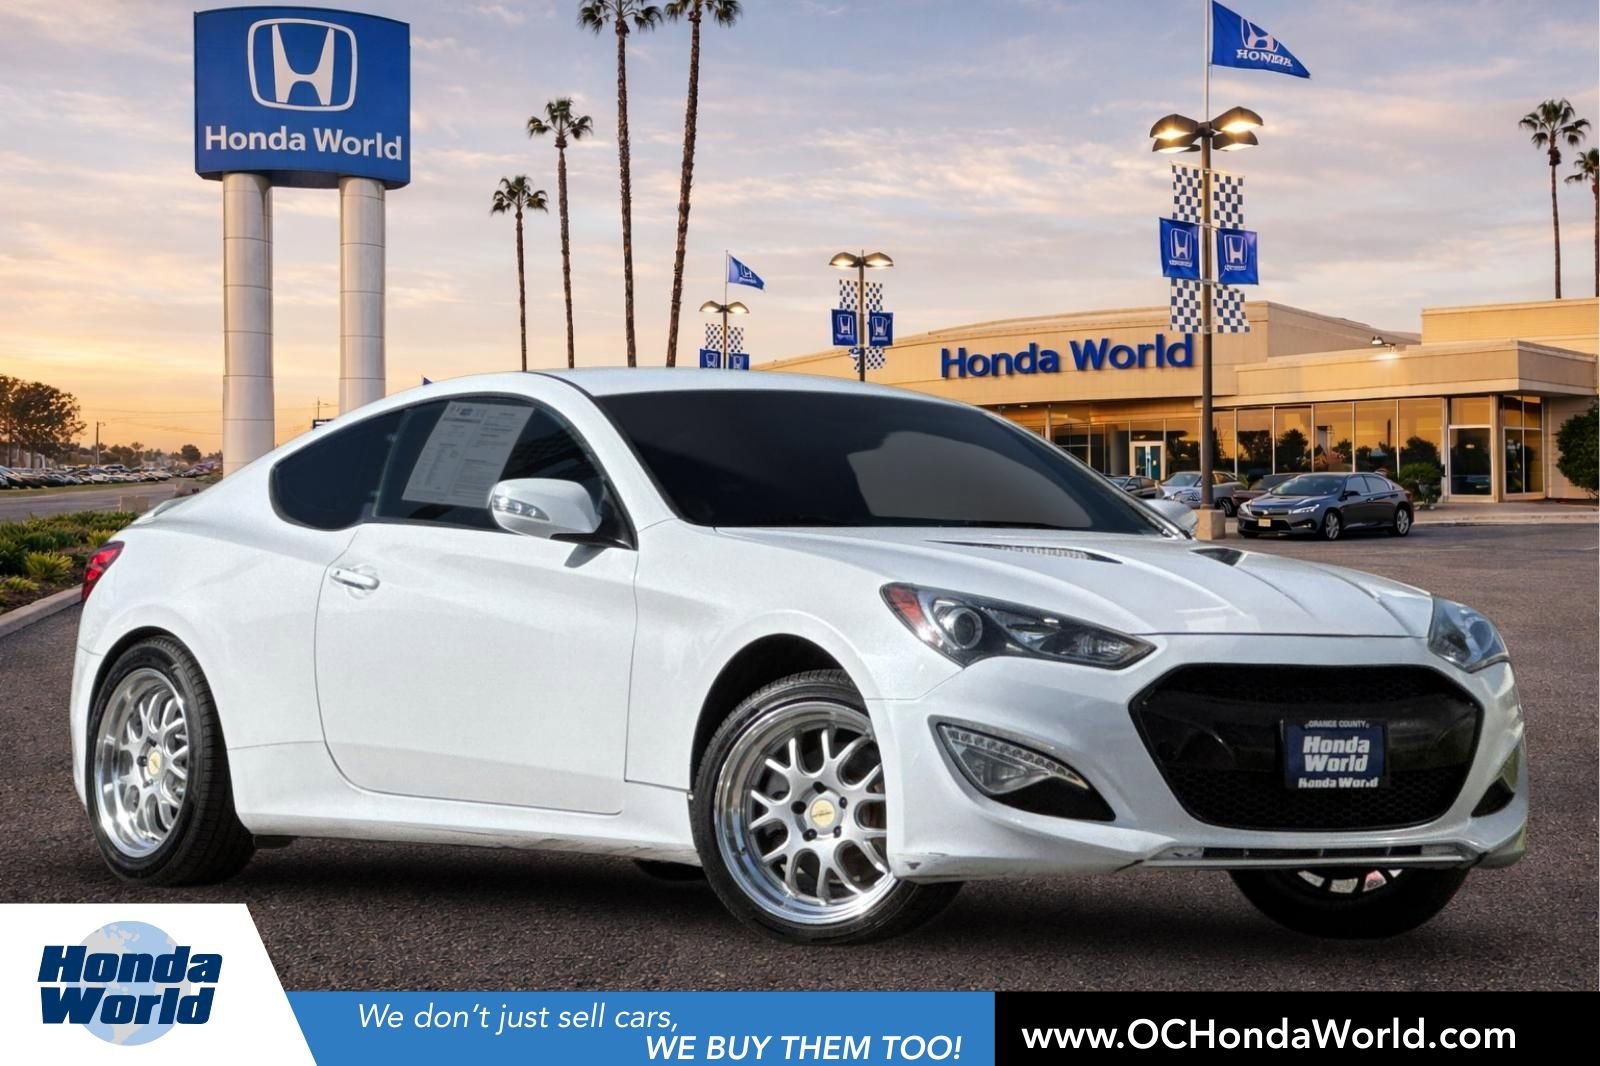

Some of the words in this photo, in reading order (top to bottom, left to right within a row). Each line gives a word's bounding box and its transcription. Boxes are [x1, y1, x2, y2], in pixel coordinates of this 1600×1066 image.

[1236, 49, 1293, 67] HONDA
[205, 125, 306, 151] Honda
[313, 127, 402, 161] World
[941, 343, 1060, 378] Honda
[1070, 332, 1194, 371] World
[1338, 720, 1366, 728] COUNTY
[1303, 736, 1370, 753] Honda
[1305, 754, 1368, 772] World
